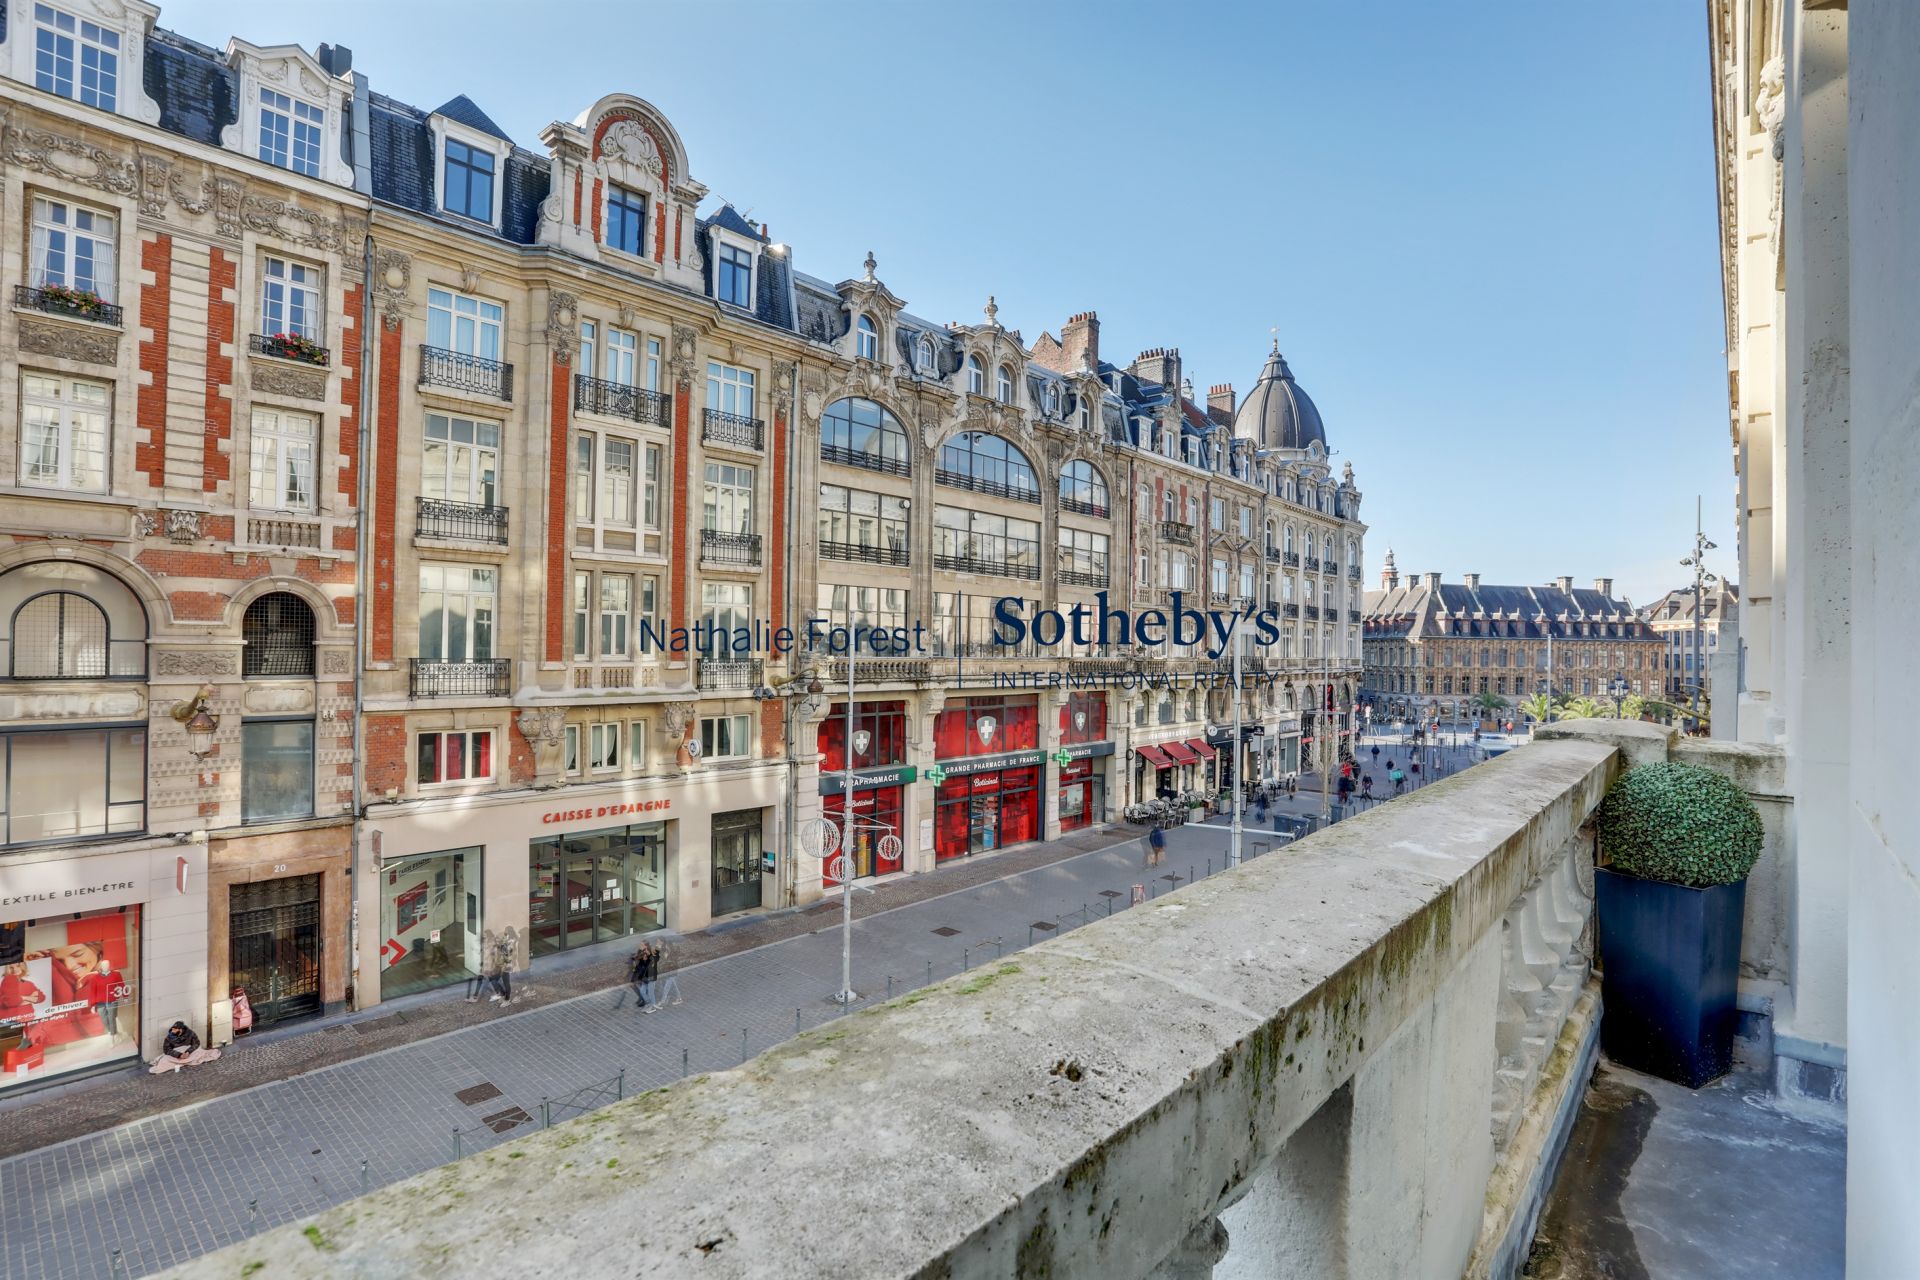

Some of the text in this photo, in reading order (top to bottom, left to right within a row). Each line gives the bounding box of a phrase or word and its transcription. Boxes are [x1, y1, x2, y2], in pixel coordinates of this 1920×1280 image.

[945, 764, 971, 774] GRANDE
[973, 760, 1007, 770] PHARMACIE
[1019, 755, 1040, 764] FRANCE
[543, 808, 593, 824] CAISSE
[274, 864, 287, 873] 20
[3, 881, 135, 905] EXTILE BIEN-ÊTRE
